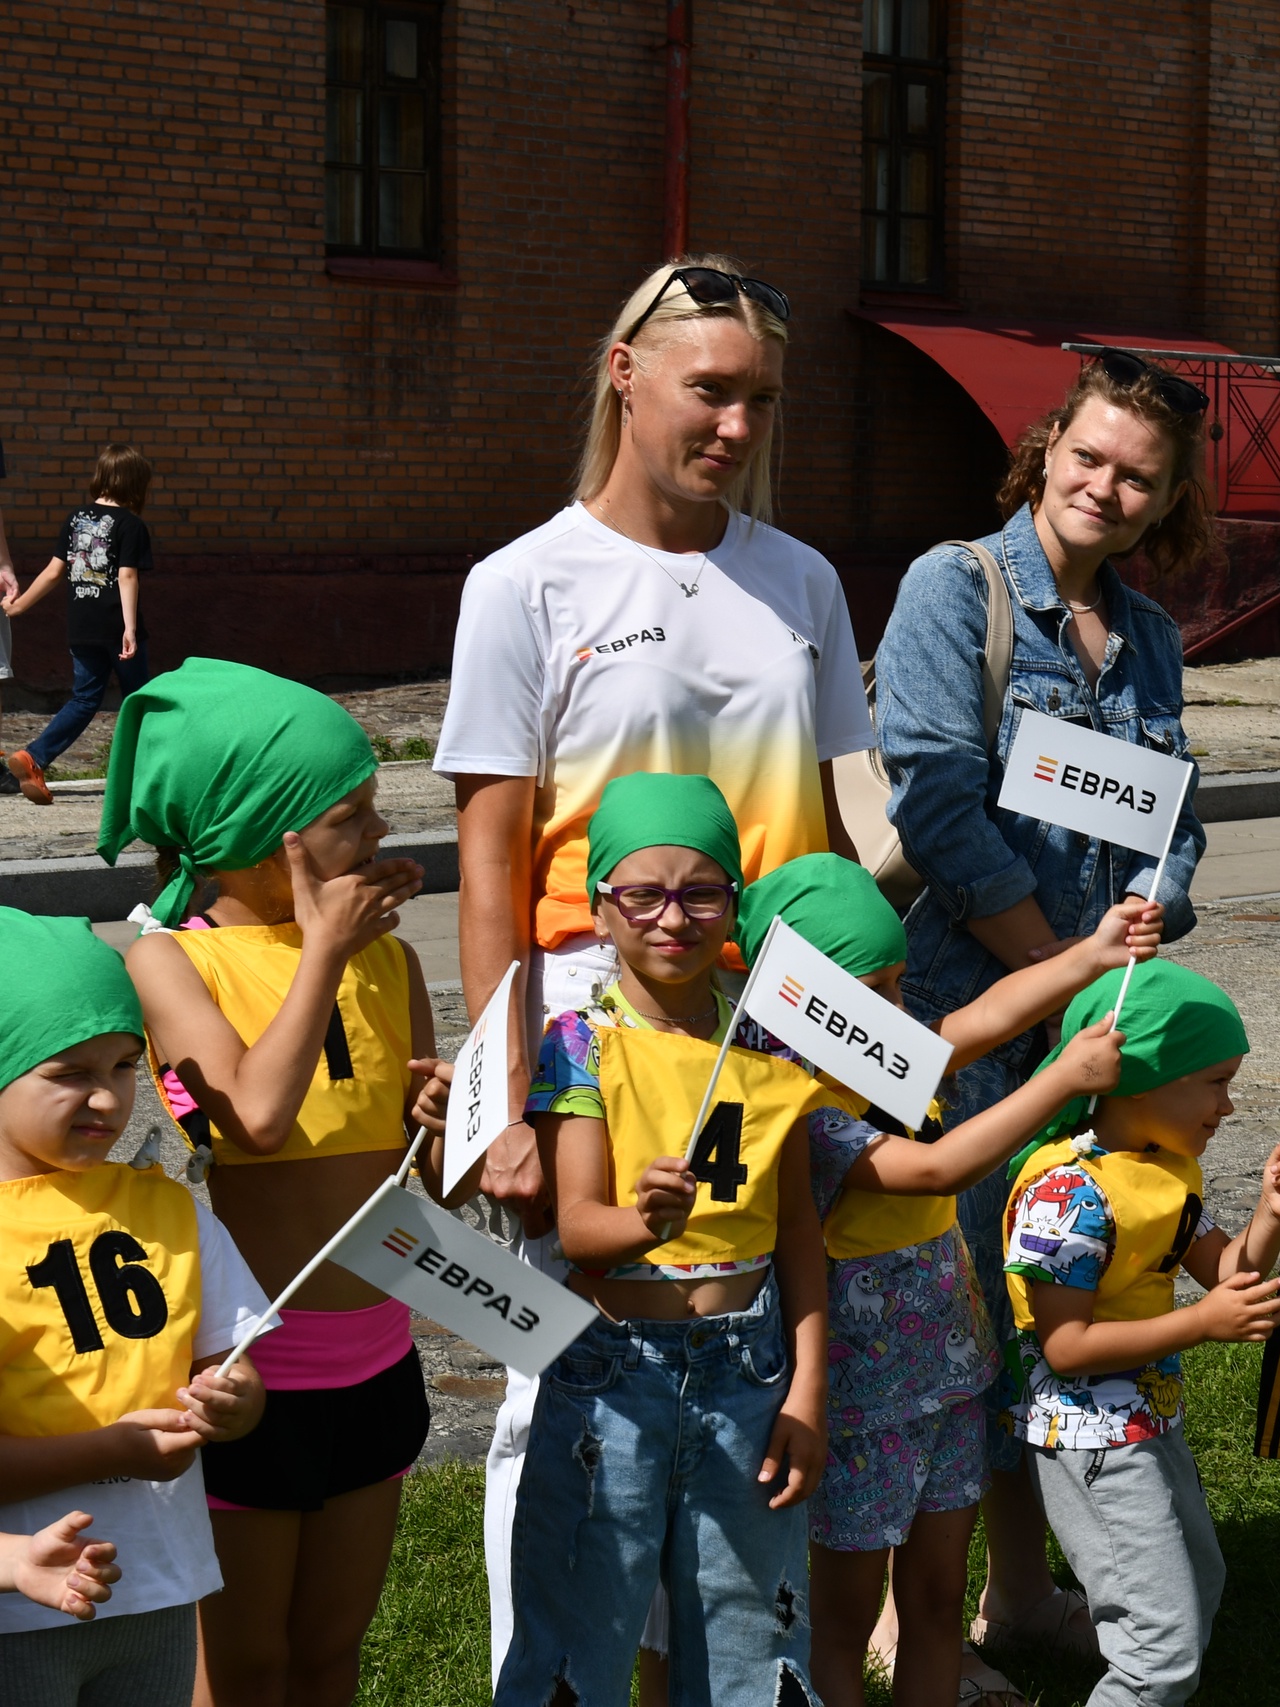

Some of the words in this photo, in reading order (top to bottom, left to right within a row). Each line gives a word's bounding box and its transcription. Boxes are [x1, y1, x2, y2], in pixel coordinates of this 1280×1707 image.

[594, 626, 666, 655] ЕВРАЗ
[1059, 763, 1157, 815] ЕВРАЗ
[804, 994, 911, 1081] ЕВРАЗ
[467, 1040, 484, 1143] ЕВРАЗ
[688, 1100, 748, 1203] 4
[25, 1229, 169, 1355] 16
[413, 1246, 541, 1333] ЕВРАЗ
[894, 1288, 933, 1315] LOVE
